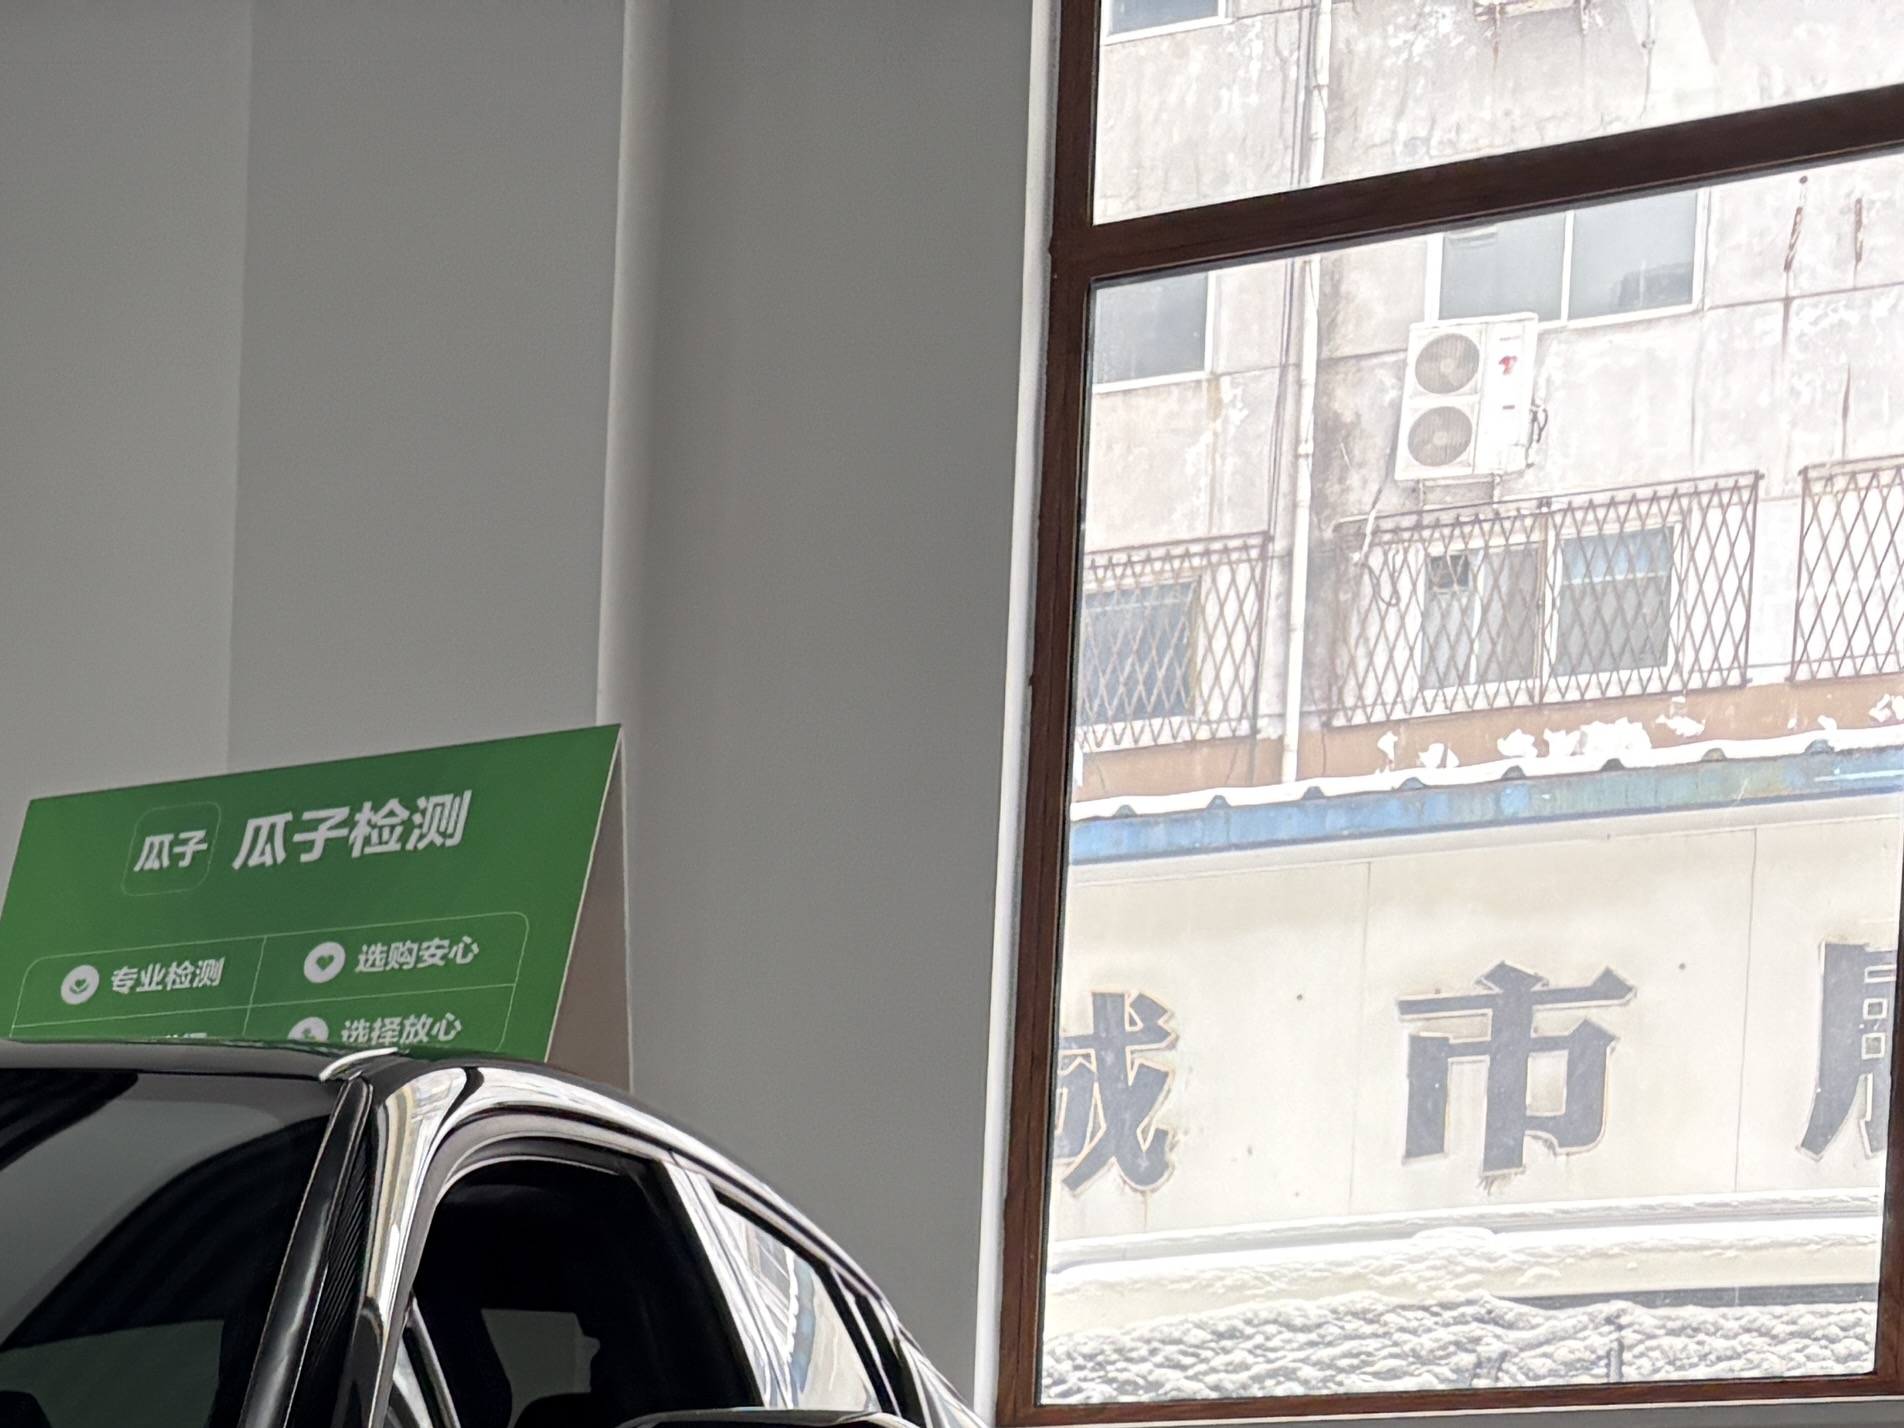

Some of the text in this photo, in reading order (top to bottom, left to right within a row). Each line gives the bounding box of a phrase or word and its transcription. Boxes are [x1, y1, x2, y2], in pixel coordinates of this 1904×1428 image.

[133, 791, 473, 872] 瓜子 瓜子检测
[355, 936, 480, 972] 选购安心
[110, 956, 226, 995] 专业检测
[341, 1012, 462, 1045] 选择放心
